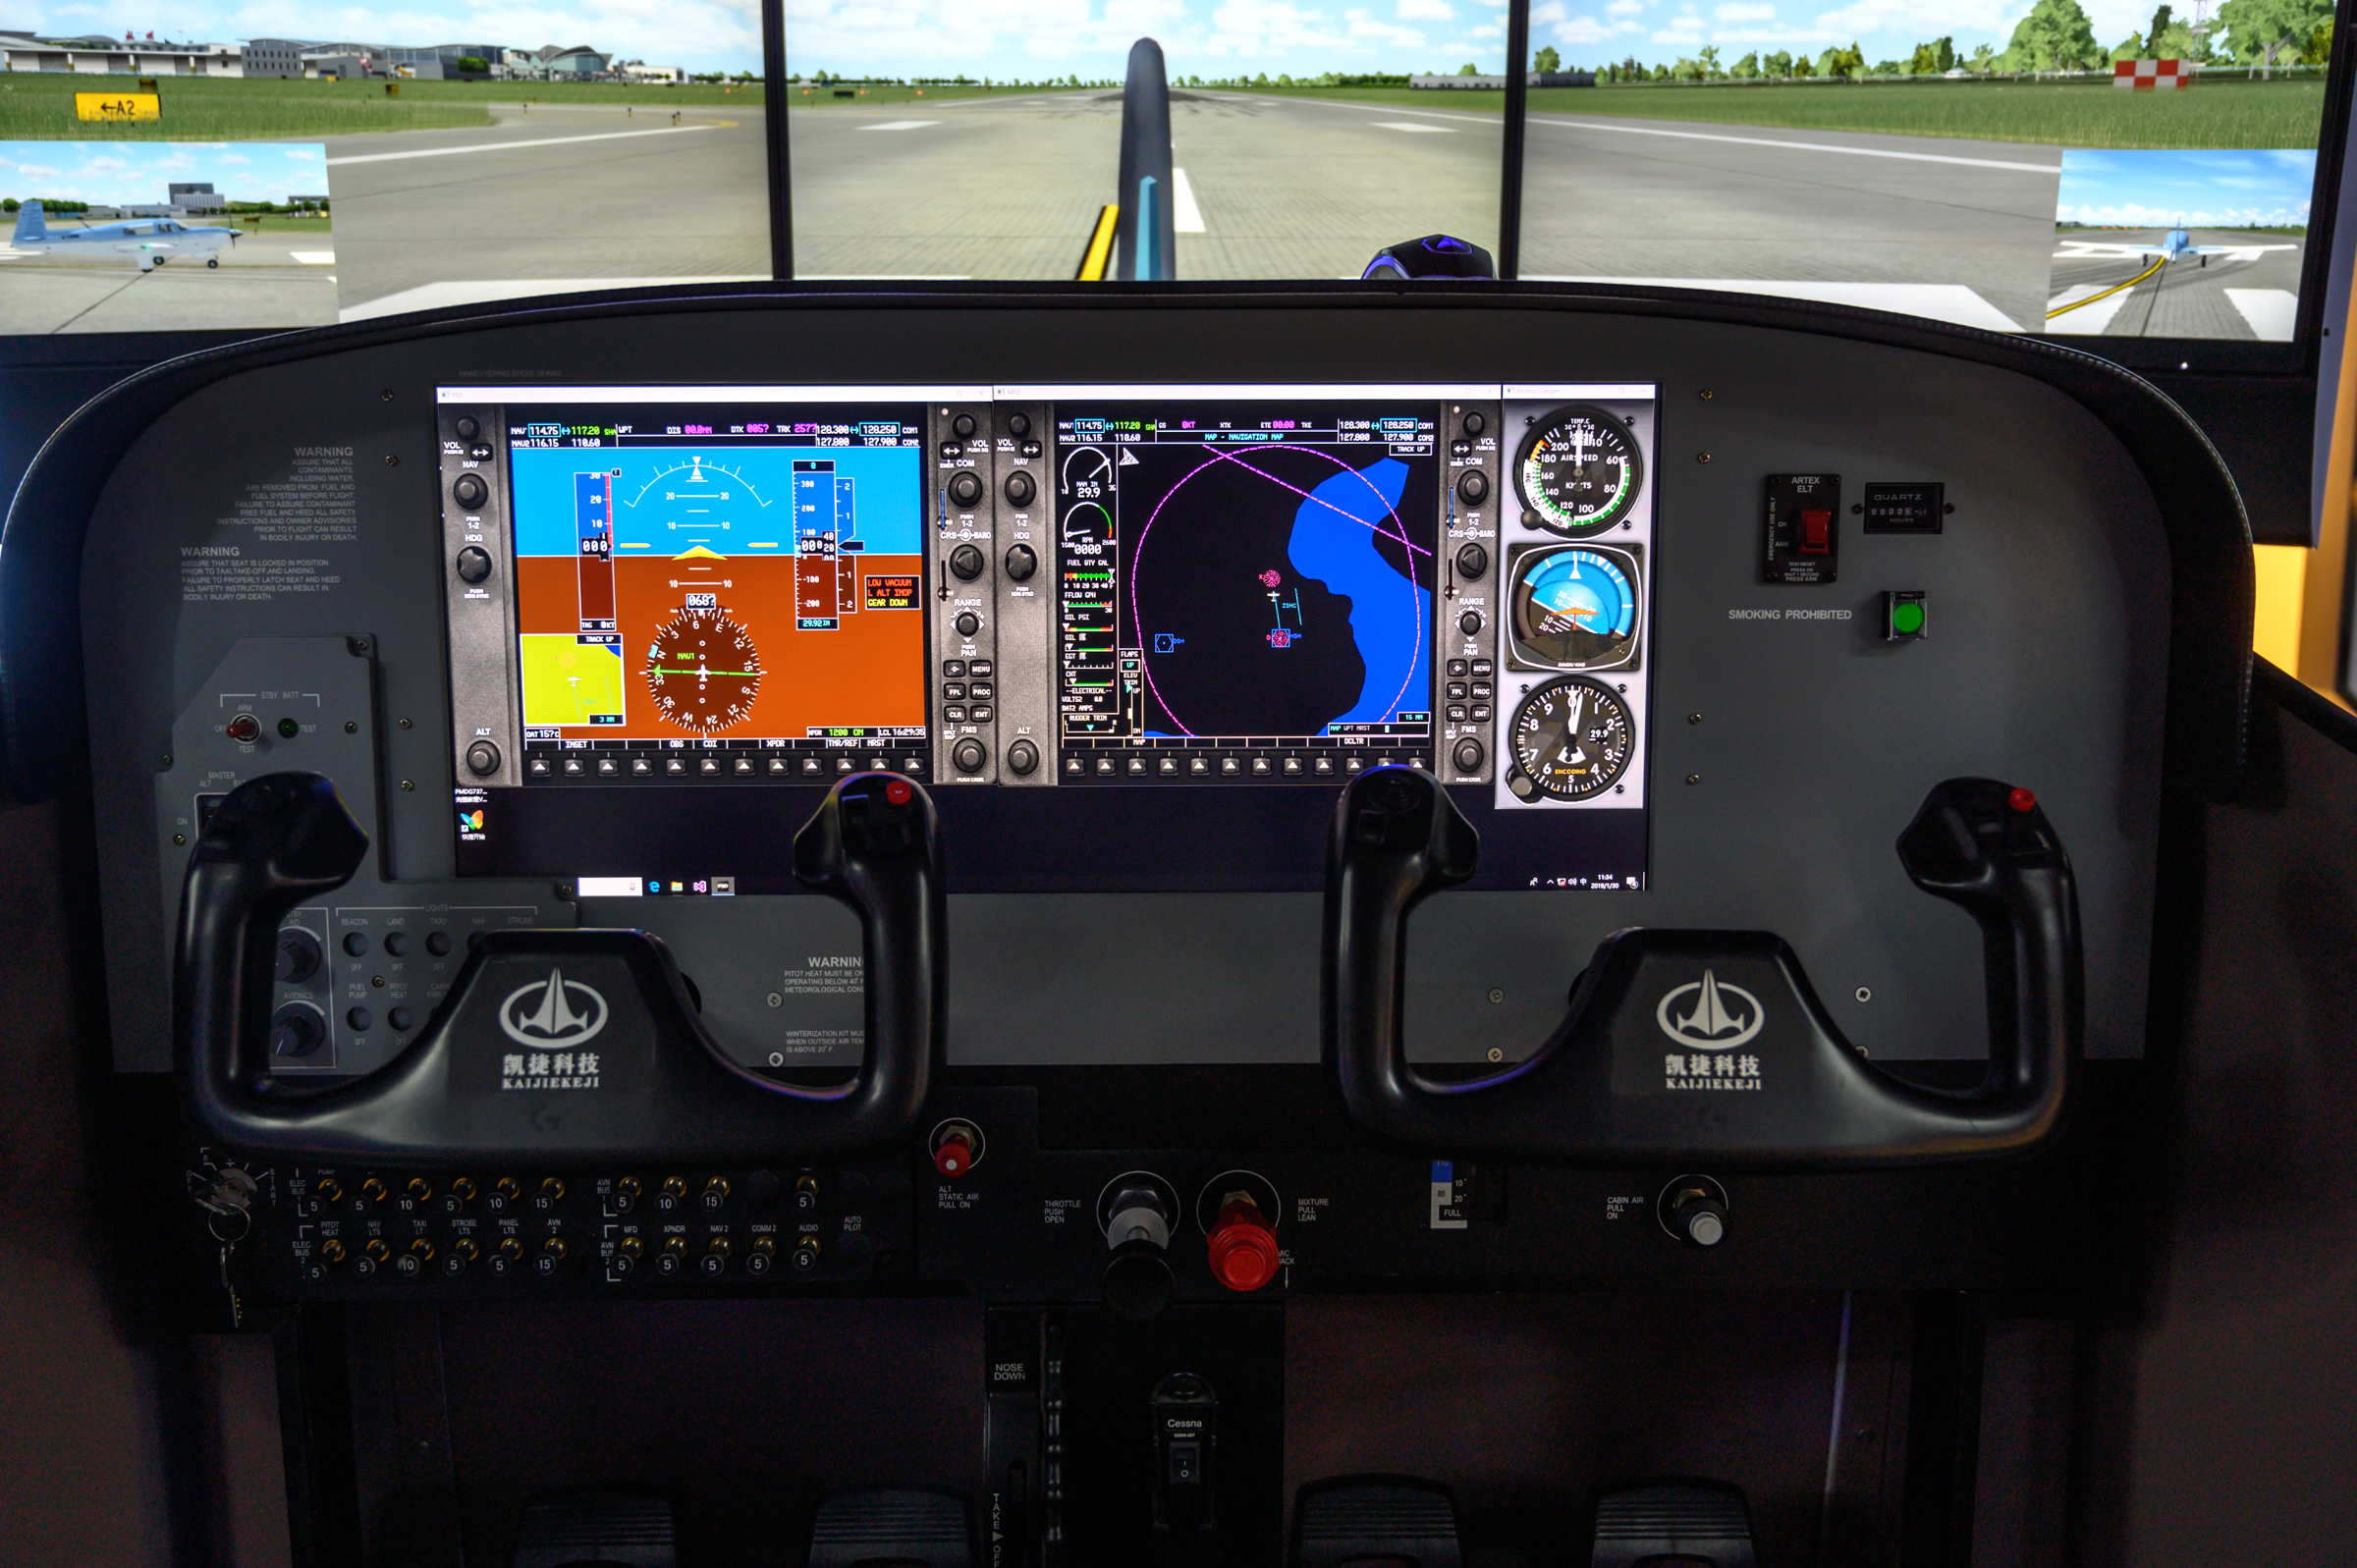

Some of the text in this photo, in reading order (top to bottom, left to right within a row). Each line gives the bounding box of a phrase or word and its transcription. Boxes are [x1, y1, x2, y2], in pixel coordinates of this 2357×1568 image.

[117, 100, 135, 115] A2
[295, 447, 354, 457] WARNING
[1077, 488, 1100, 498] 29.9
[181, 547, 240, 556] WARNING
[1728, 610, 1851, 619] SMOKING PROHIBITED
[1544, 703, 1553, 715] 9
[1530, 719, 1539, 730] 8
[1607, 719, 1615, 730] 2
[1591, 730, 1608, 738] 29.9
[1530, 749, 1539, 760] 7
[1605, 749, 1613, 760] 3
[1543, 763, 1552, 774] 6
[1590, 764, 1599, 775] 4
[808, 957, 863, 967] WARNIN
[503, 1053, 599, 1075] 凯捷科技
[1666, 1054, 1760, 1076] 凯捷科技
[503, 1077, 599, 1089] KAIJIEKEJI
[1666, 1078, 1761, 1089] KAIJIEKEJI
[401, 1200, 412, 1210] 10
[535, 1199, 547, 1208] 15
[705, 1197, 717, 1206] 15
[1168, 1419, 1202, 1428] Cessna
